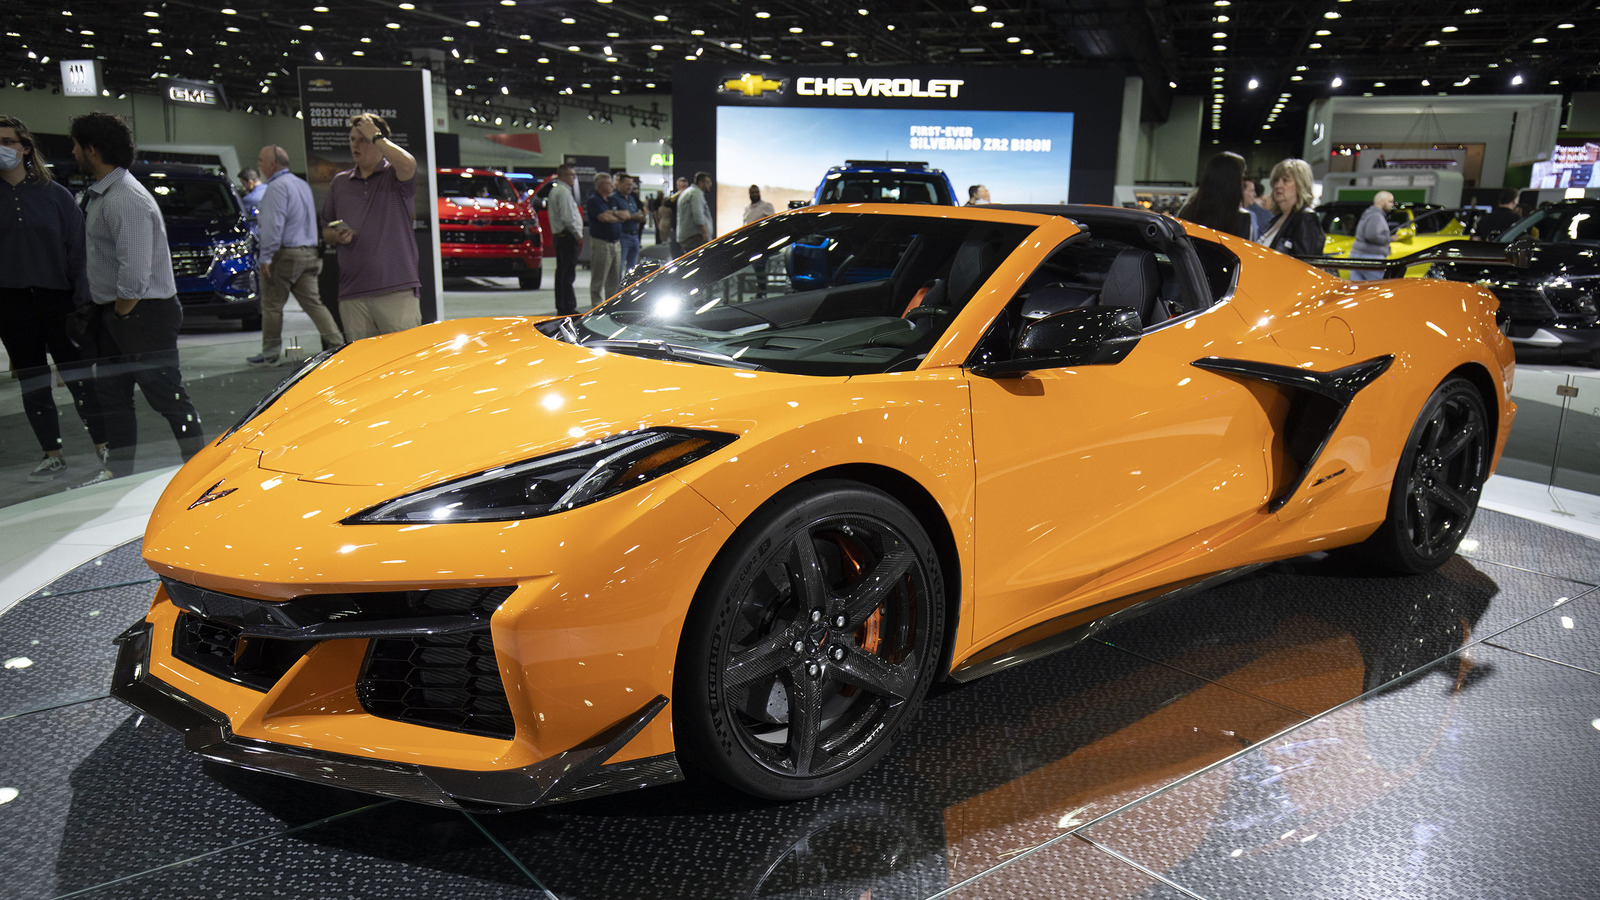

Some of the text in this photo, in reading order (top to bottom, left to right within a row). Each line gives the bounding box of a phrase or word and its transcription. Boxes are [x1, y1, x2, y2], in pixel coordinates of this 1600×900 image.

[797, 77, 965, 98] CHEVROLET
[310, 108, 332, 117] 2023
[380, 109, 398, 118] ZR2
[311, 118, 343, 127] DESERT
[910, 126, 973, 138] FIRST-EVER
[909, 137, 1052, 152] SILVERADO ZR2 BISON
[847, 722, 885, 757] CORVETTE
